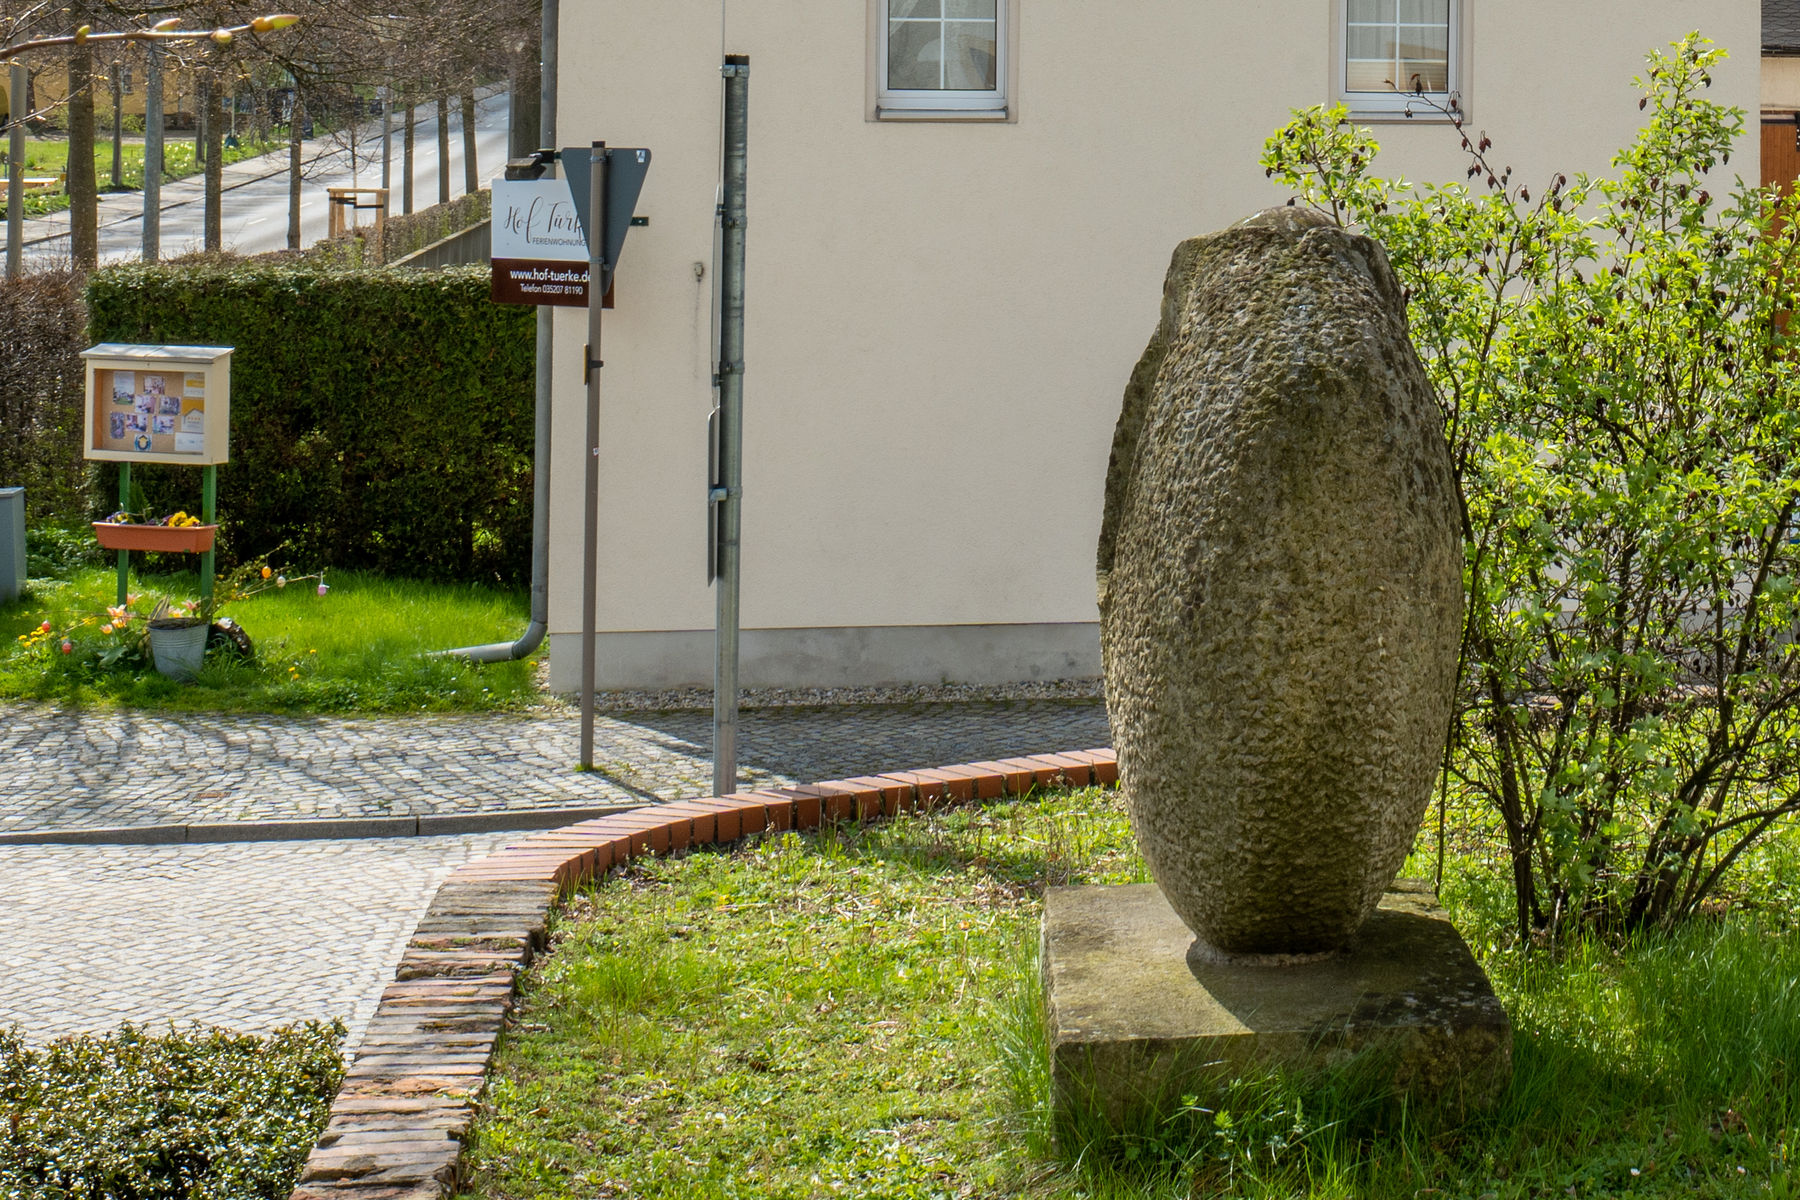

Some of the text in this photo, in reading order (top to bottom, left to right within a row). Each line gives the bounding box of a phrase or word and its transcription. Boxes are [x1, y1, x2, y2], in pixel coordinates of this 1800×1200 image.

[504, 196, 583, 243] Hof Türk
[520, 283, 583, 295] Telefon 035207 81190
